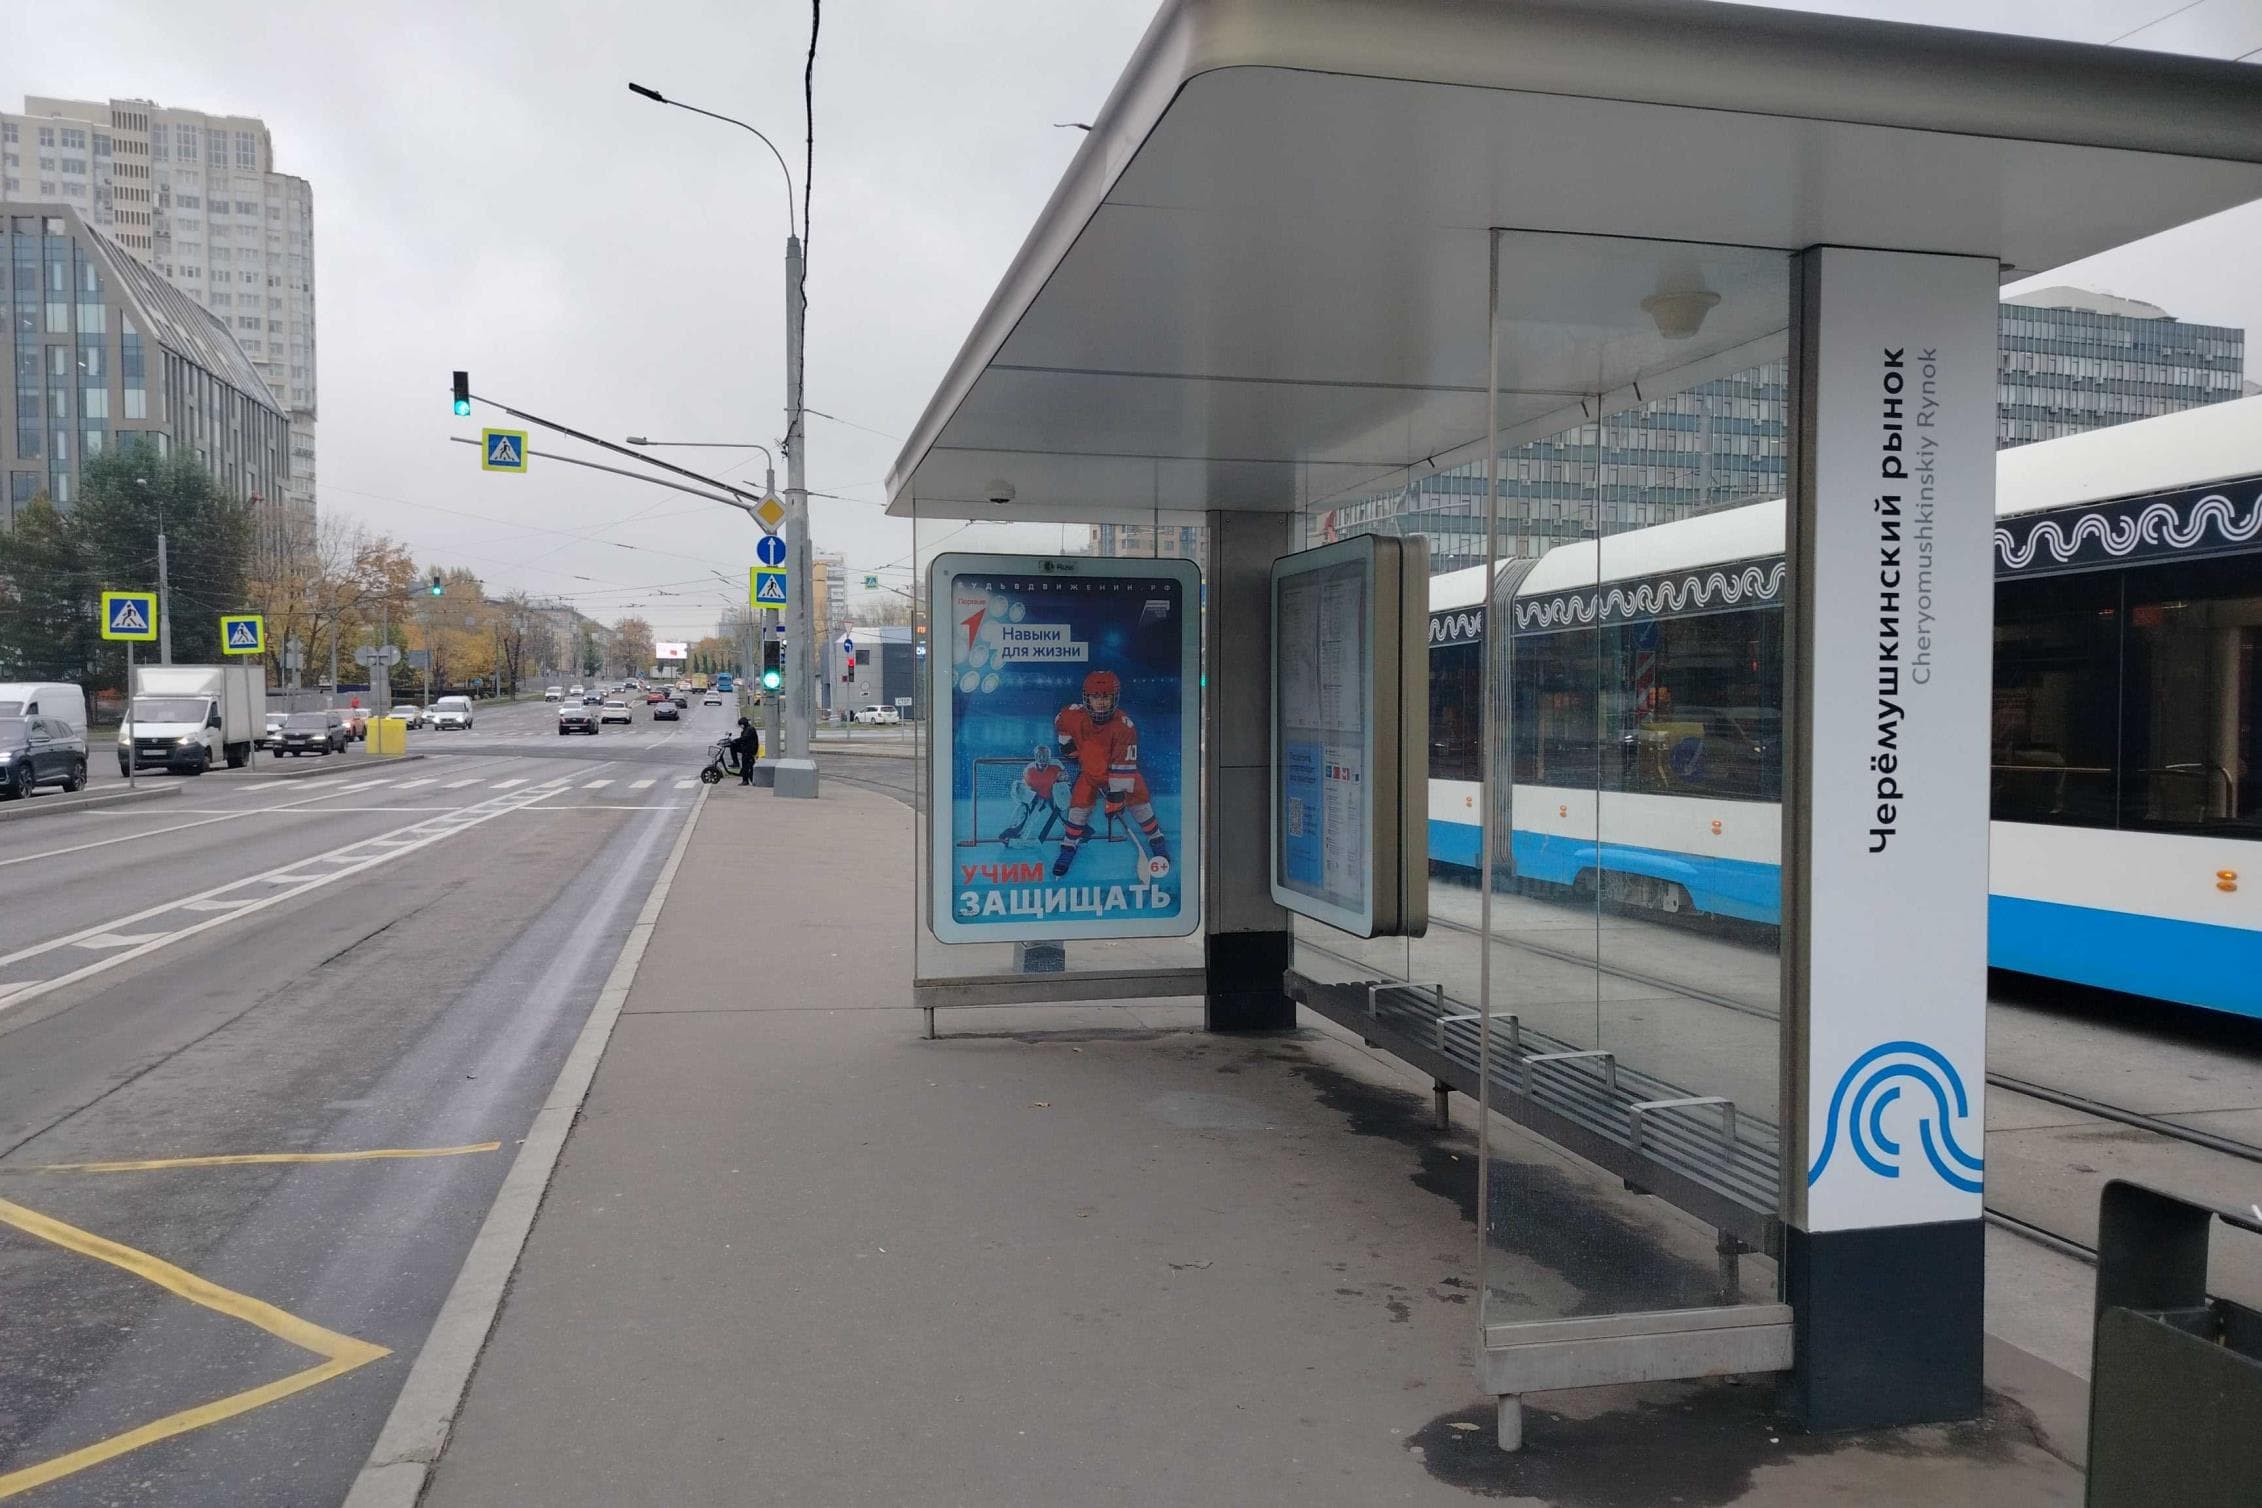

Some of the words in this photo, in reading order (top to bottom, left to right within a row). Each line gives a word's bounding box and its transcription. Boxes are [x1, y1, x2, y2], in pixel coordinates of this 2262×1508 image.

[1917, 348, 1940, 427] Rynok
[1882, 348, 1908, 479] рынок
[1912, 436, 1939, 685] Cheryomushkinskiy
[1002, 627, 1061, 641] Навыки
[1002, 647, 1030, 658] для
[1033, 646, 1081, 657] жизни
[1869, 496, 1905, 853] Черёмушкинский
[961, 863, 1044, 884] УЧИМ
[1150, 861, 1168, 873] 6+
[960, 884, 1171, 919] ЗАЩИЩАТЬ
